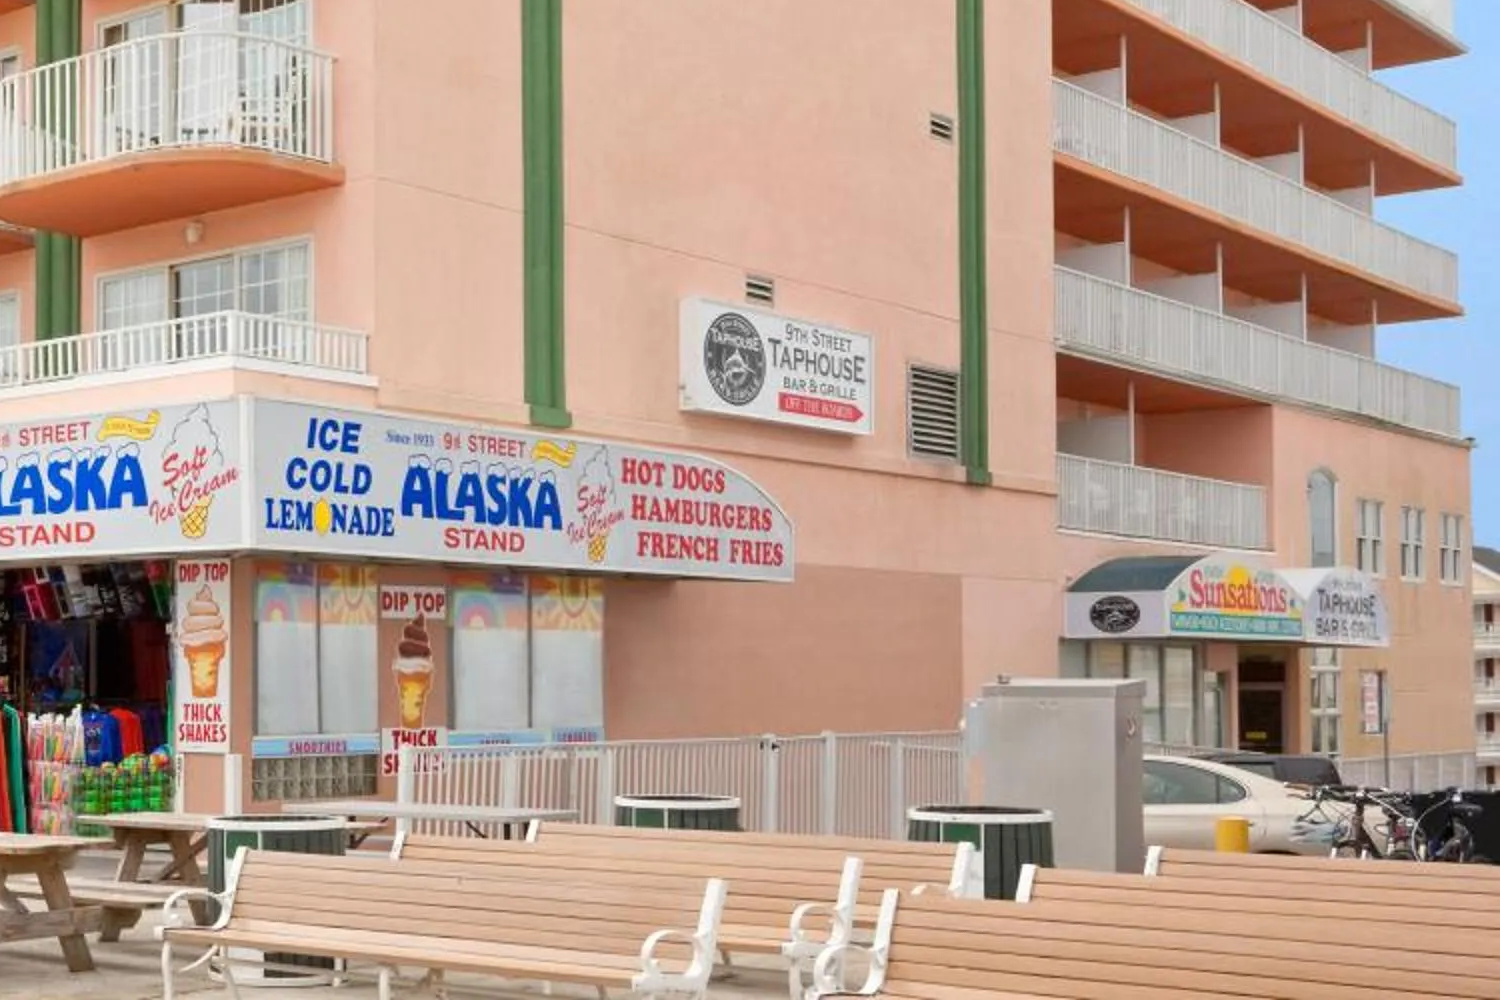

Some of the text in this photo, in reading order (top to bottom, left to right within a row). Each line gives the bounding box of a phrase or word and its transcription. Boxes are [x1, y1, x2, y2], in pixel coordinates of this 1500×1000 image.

[812, 328, 852, 352] STREET
[767, 337, 866, 384] TAPHOUSE
[783, 376, 807, 391] BAR
[19, 421, 91, 447] STREET
[307, 417, 362, 454] ICE
[468, 434, 526, 458] STREET
[162, 445, 207, 487] Soft
[286, 457, 372, 495] COLD
[621, 457, 725, 493] HOT DOGS
[149, 467, 238, 524] Ice Cream
[402, 462, 562, 530] ALASKA
[631, 494, 773, 532] HAMBURGERS
[444, 527, 525, 552] STAND
[637, 531, 783, 567] FRENCH FRIES
[180, 562, 228, 582] DIP TOP
[382, 592, 445, 613] DIP TOP
[1188, 568, 1287, 613] Sunsations
[1316, 588, 1376, 617] TAPHOUSE
[1316, 618, 1339, 636] BAR
[183, 703, 222, 722] THICK
[179, 723, 227, 743] SHAKES
[391, 730, 437, 749] THICK
